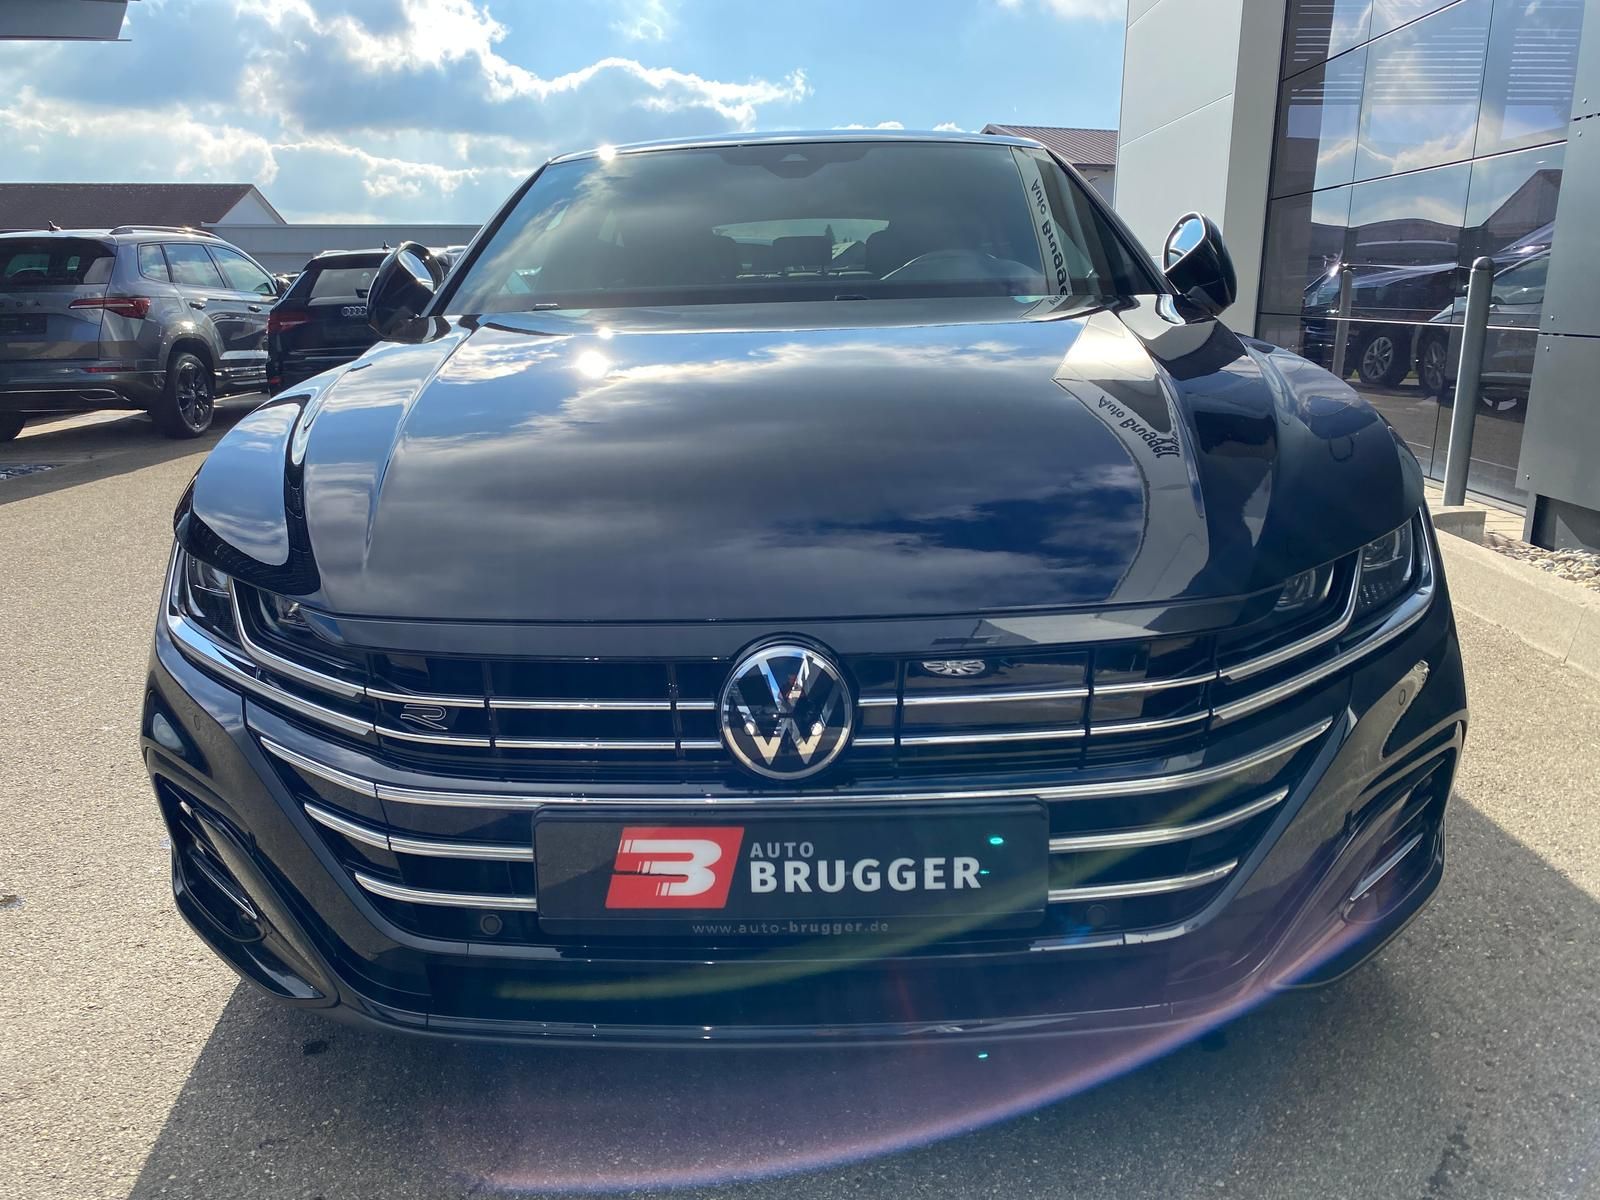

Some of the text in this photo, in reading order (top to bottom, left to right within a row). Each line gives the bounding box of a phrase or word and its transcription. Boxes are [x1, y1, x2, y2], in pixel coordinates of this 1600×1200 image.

[750, 841, 815, 859] AUTO
[750, 856, 983, 894] BRUGGER
[692, 920, 890, 937] www.auto-brugger.de
